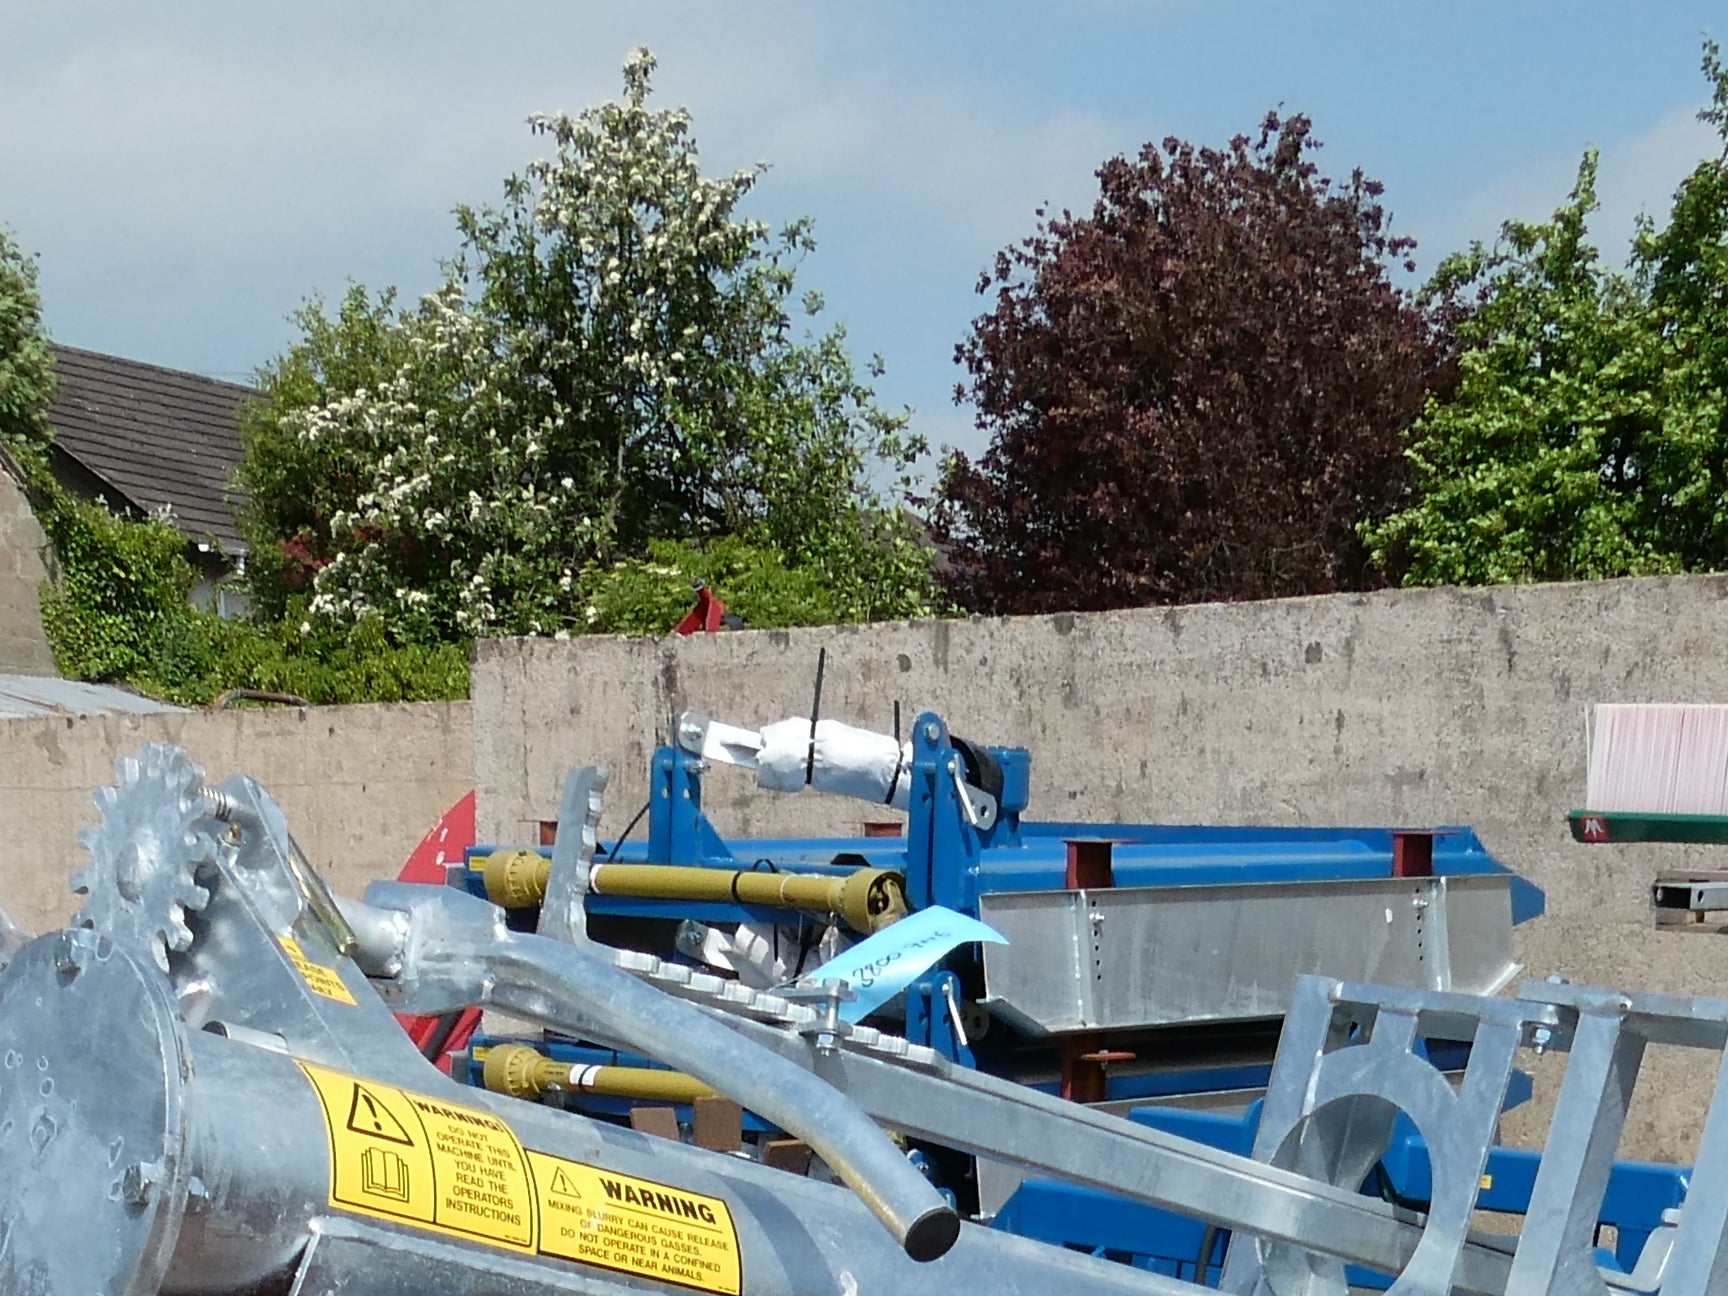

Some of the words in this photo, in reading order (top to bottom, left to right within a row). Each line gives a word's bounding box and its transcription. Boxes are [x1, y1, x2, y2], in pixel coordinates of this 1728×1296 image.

[437, 1132, 483, 1151] OPERATE
[488, 1145, 510, 1158] THIS
[448, 1125, 464, 1136] DO
[468, 1130, 488, 1142] NOT
[437, 1143, 482, 1162] MACHINE
[488, 1157, 516, 1172] UNTIL
[455, 1160, 476, 1173] YOU
[480, 1166, 505, 1181] HAVE
[453, 1186, 513, 1209] OPERATORS
[456, 1173, 484, 1188] READ
[489, 1181, 508, 1194] THE
[446, 1198, 520, 1225] INSTRUCTIONS
[599, 1177, 716, 1225] WARNING
[548, 1199, 582, 1216] MIXING
[587, 1209, 623, 1225] SLURRY
[628, 1219, 648, 1231] CAN
[652, 1224, 683, 1240] CAUSE
[687, 1233, 728, 1251] RELEASE
[580, 1219, 591, 1229] OF
[597, 1223, 657, 1245] DANGEROUS
[661, 1239, 702, 1256] GASSES.
[560, 1227, 576, 1238] DO
[579, 1232, 599, 1244] NOT
[603, 1237, 646, 1255] OPERATE
[650, 1247, 660, 1258] IN
[664, 1250, 669, 1260] A
[674, 1252, 721, 1273] CONFINED
[578, 1244, 610, 1260] SPACE
[614, 1252, 628, 1264] OR
[632, 1257, 658, 1271] NEAR
[661, 1264, 704, 1281] ANIMALS.
